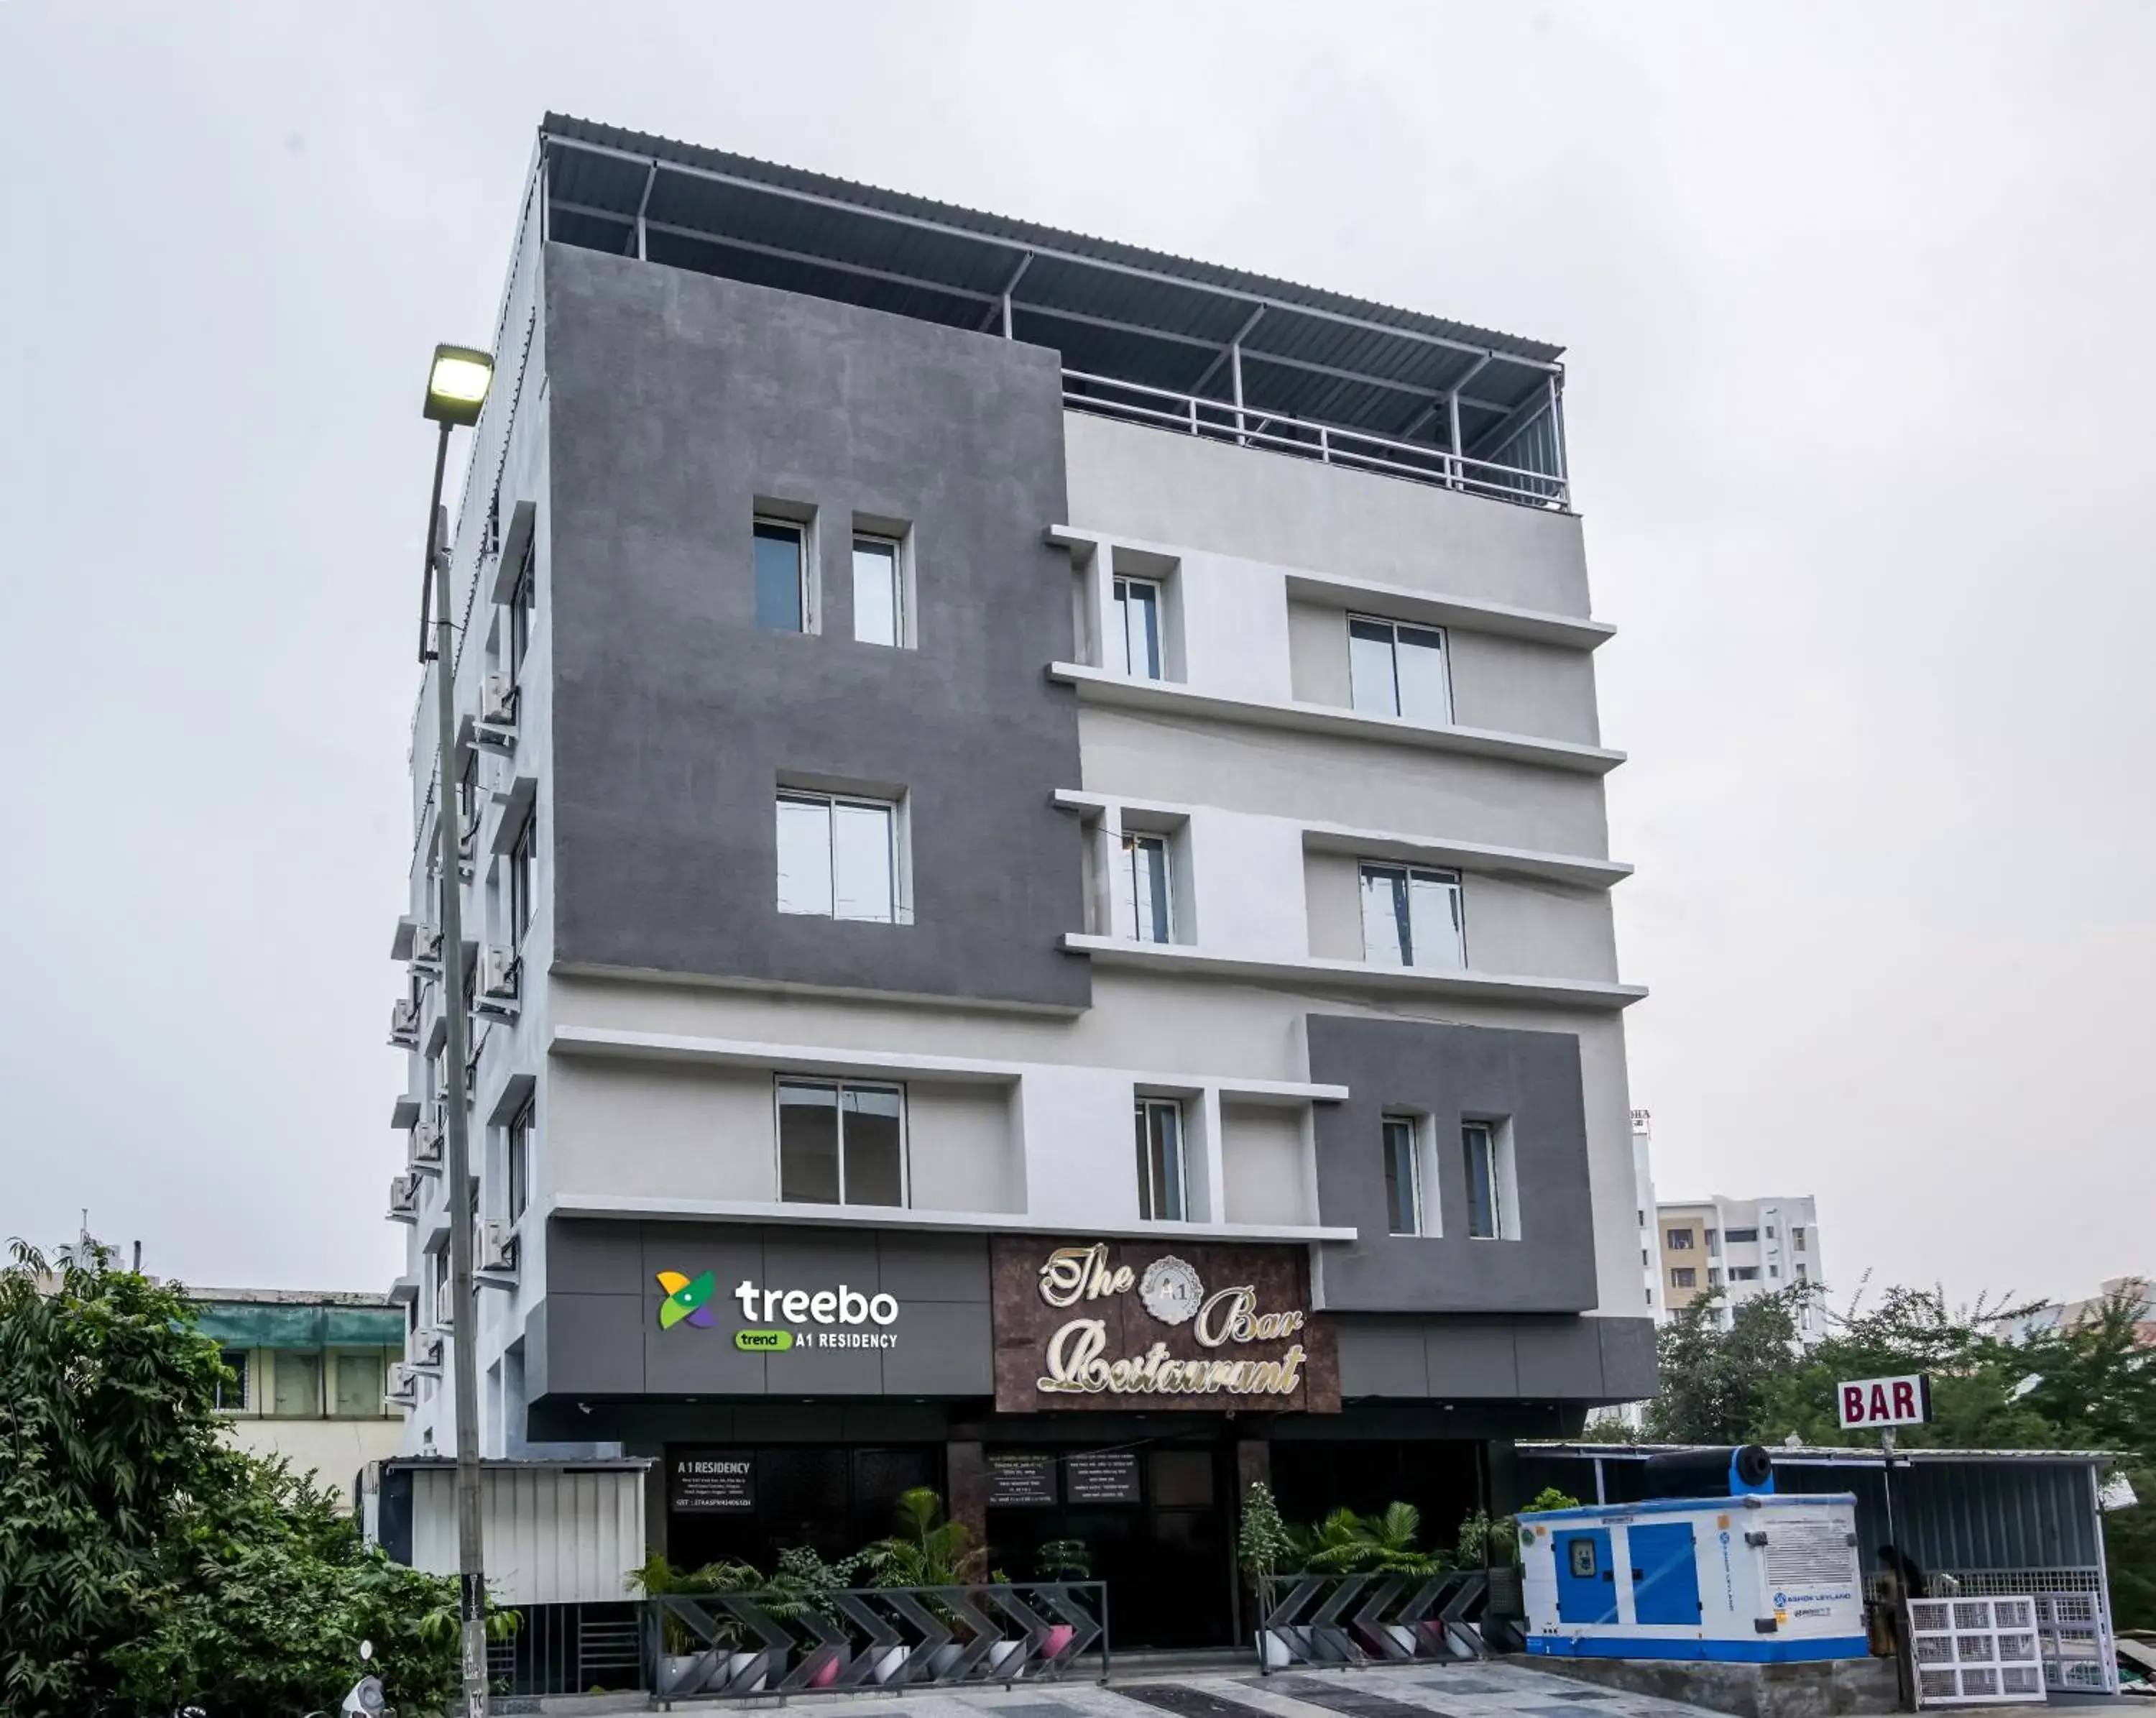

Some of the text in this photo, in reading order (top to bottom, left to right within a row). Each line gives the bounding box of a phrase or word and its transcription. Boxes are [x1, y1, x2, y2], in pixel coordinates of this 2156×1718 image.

[1038, 1242, 1135, 1308] The
[735, 1280, 899, 1325] treebo
[1194, 1284, 1304, 1349] Bar
[741, 1333, 778, 1346] trend
[796, 1333, 898, 1349] A1 RESIDENCY
[1037, 1318, 1307, 1395] Restaurant
[1844, 1381, 1917, 1423] BAR
[678, 1461, 686, 1473] A
[695, 1461, 750, 1474] RESIDENCY
[1815, 1592, 1851, 1601] LEYLAND
